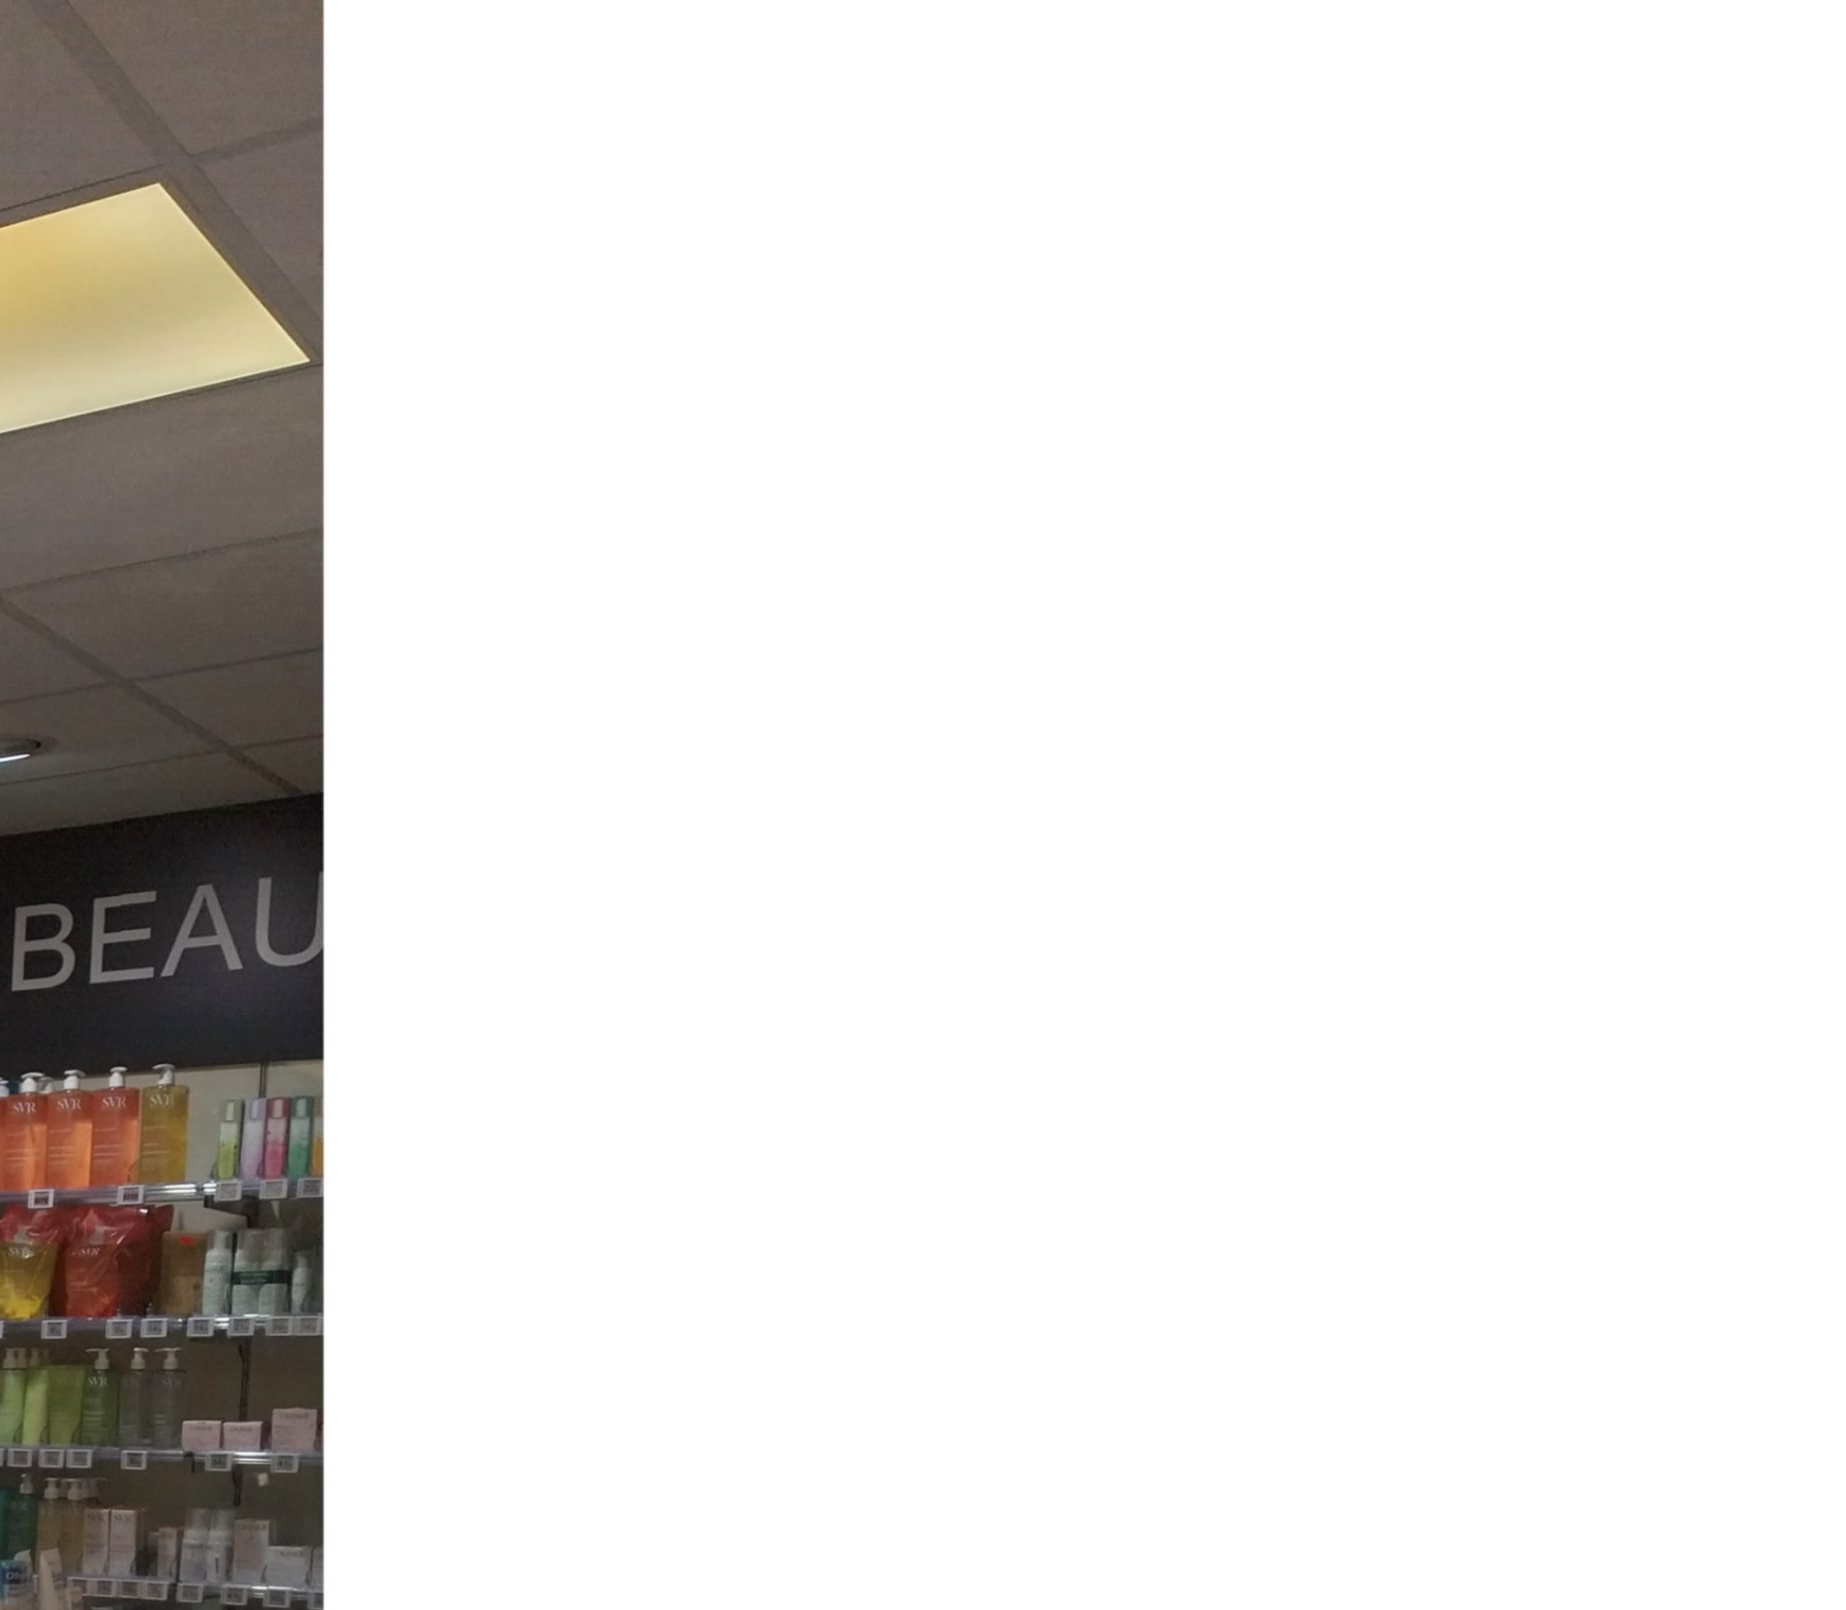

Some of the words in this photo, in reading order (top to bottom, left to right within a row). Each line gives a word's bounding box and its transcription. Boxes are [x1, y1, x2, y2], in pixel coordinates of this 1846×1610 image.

[12, 876, 323, 991] BEAU
[57, 1097, 82, 1111] SVR
[102, 1096, 127, 1109] SVR
[149, 1094, 174, 1106] SVR
[12, 1101, 37, 1115] SVR
[8, 1247, 30, 1257] SVR
[80, 1247, 100, 1257] SVR
